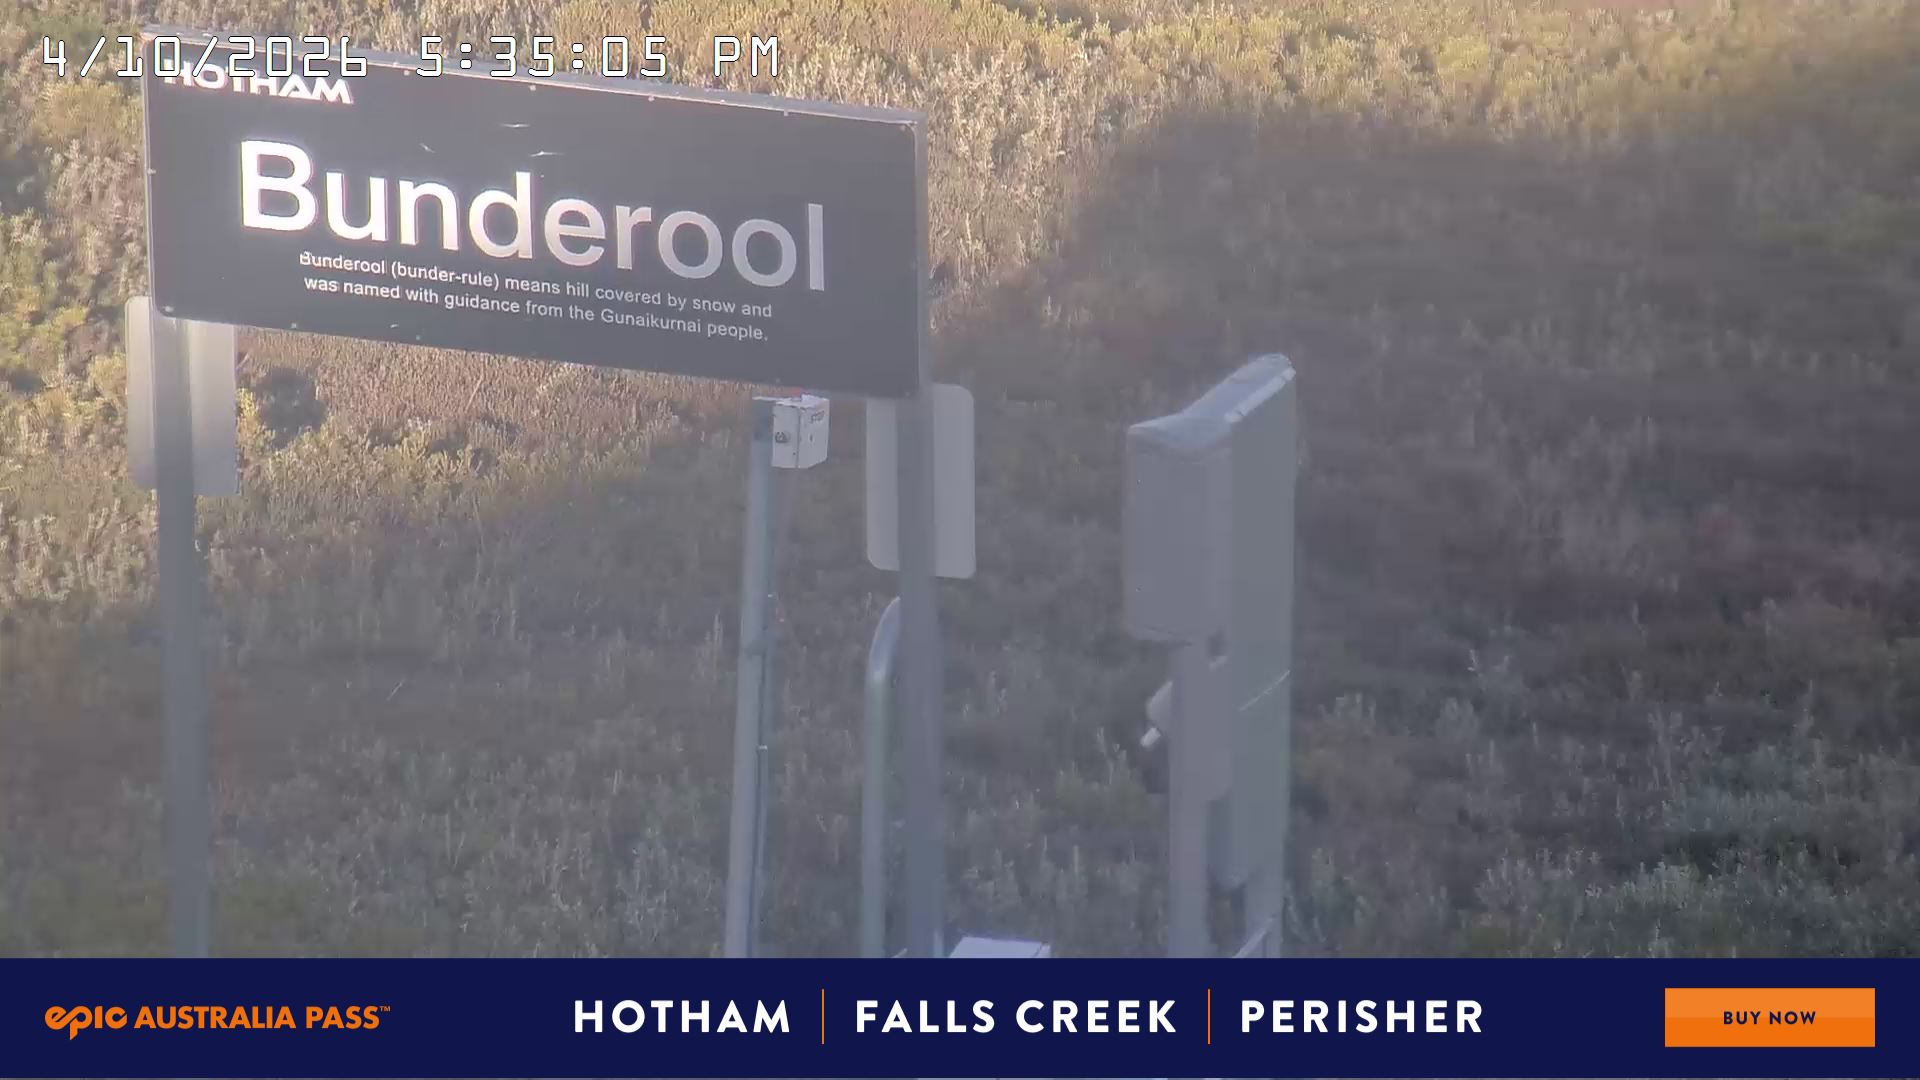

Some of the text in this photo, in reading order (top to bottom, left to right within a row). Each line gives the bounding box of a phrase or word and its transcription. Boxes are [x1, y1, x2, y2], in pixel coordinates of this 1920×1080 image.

[163, 58, 355, 104] HOTHAM
[240, 139, 826, 292] Bunderool
[299, 250, 773, 318] Bunderool (bunder-rule) means hill covered by snow and
[303, 276, 769, 341] was named with guidance from the Gunaikurnai people.
